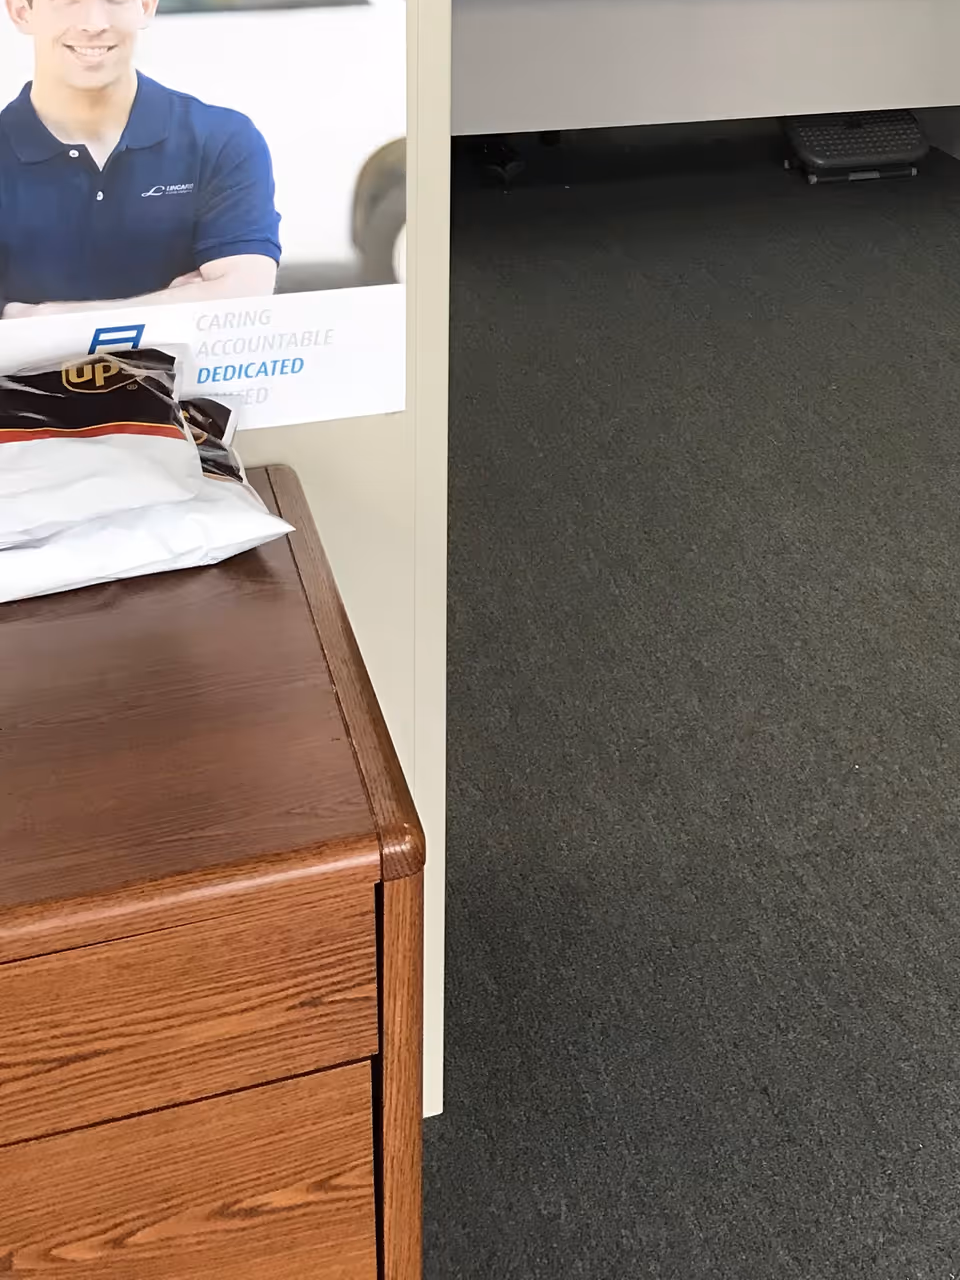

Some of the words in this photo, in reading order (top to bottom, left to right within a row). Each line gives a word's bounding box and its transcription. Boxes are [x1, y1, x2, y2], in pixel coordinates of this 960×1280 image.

[195, 308, 272, 332] CARING
[195, 328, 334, 358] ACCOUNTABLE
[69, 361, 120, 387] up
[197, 357, 304, 384] DEDICATED
